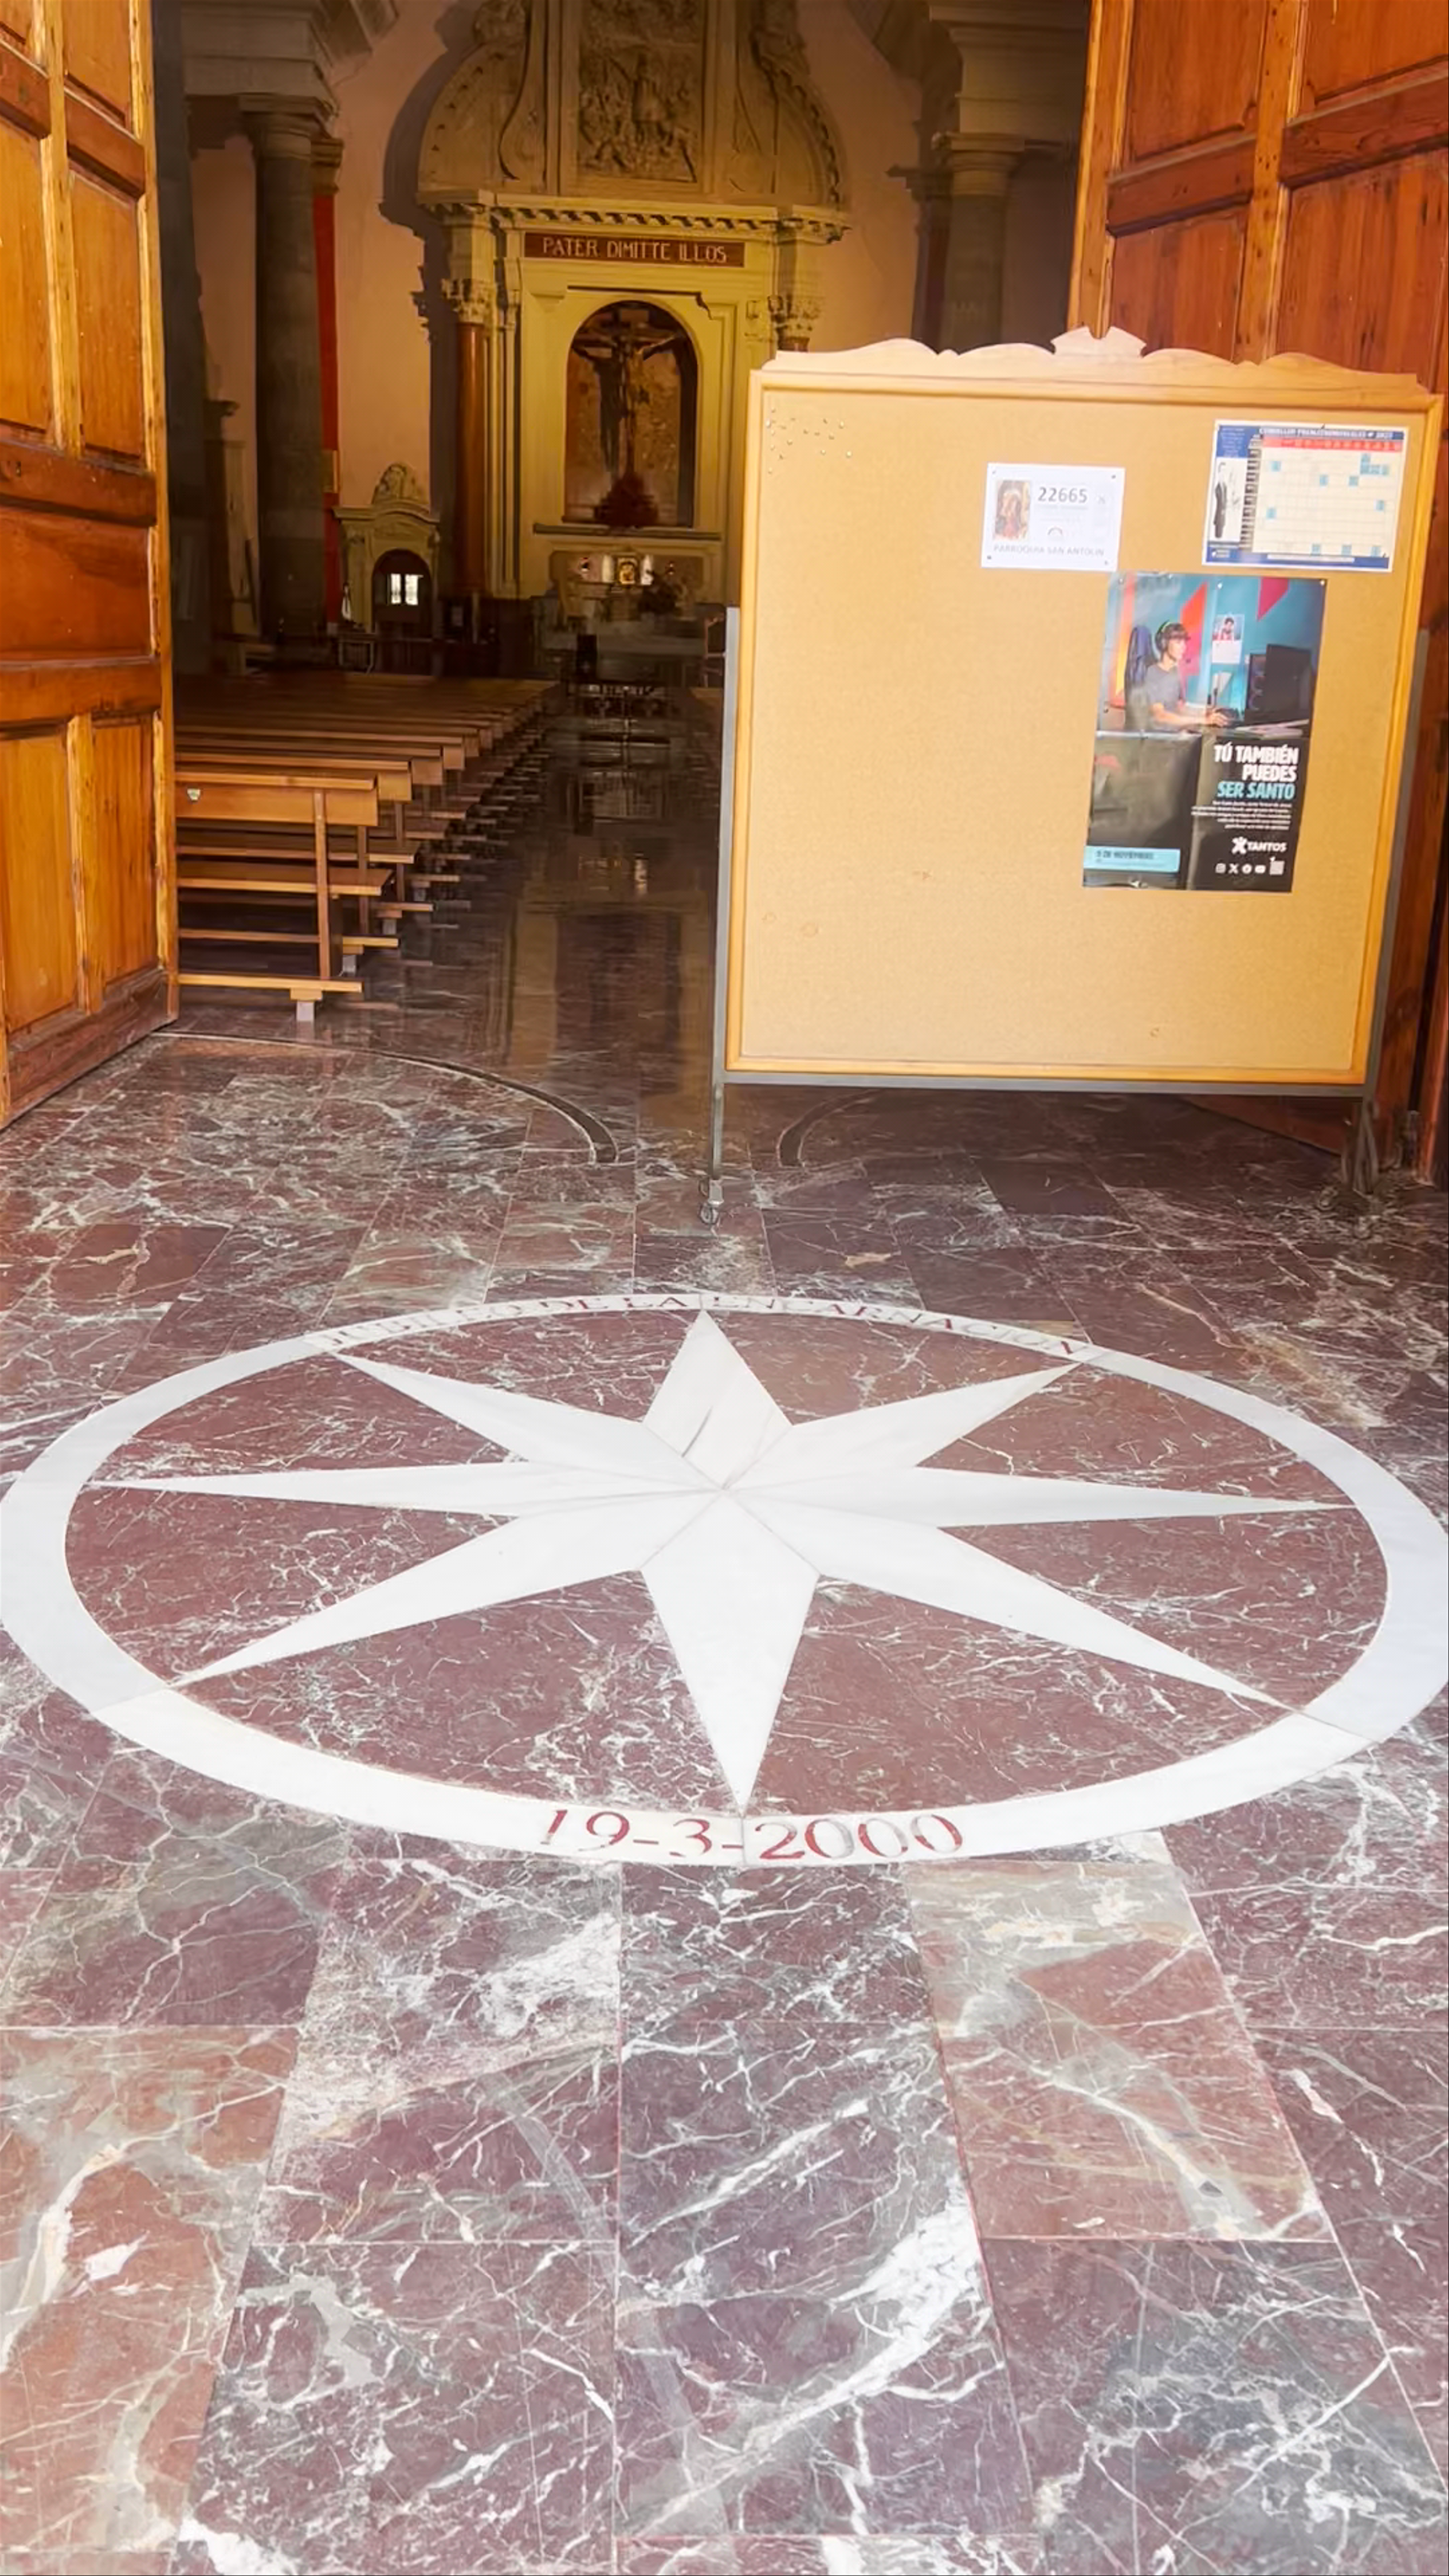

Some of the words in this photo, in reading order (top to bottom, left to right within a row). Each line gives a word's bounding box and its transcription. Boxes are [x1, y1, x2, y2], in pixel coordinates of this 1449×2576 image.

[543, 237, 598, 257] PATER
[607, 240, 671, 260] DIMITTE
[679, 243, 727, 263] ILLOS
[1038, 487, 1088, 503] 22665
[994, 544, 1044, 554] PARROQUIA
[1048, 546, 1064, 555] SAN
[1214, 741, 1233, 762] TÚ
[1235, 744, 1299, 764] TAMBIÉN
[1242, 764, 1297, 782] PUEDES
[1217, 781, 1244, 798] SER
[1246, 783, 1295, 800] SANTO
[623, 1297, 687, 1307] LA
[539, 1809, 964, 1859] 19-3-2000
